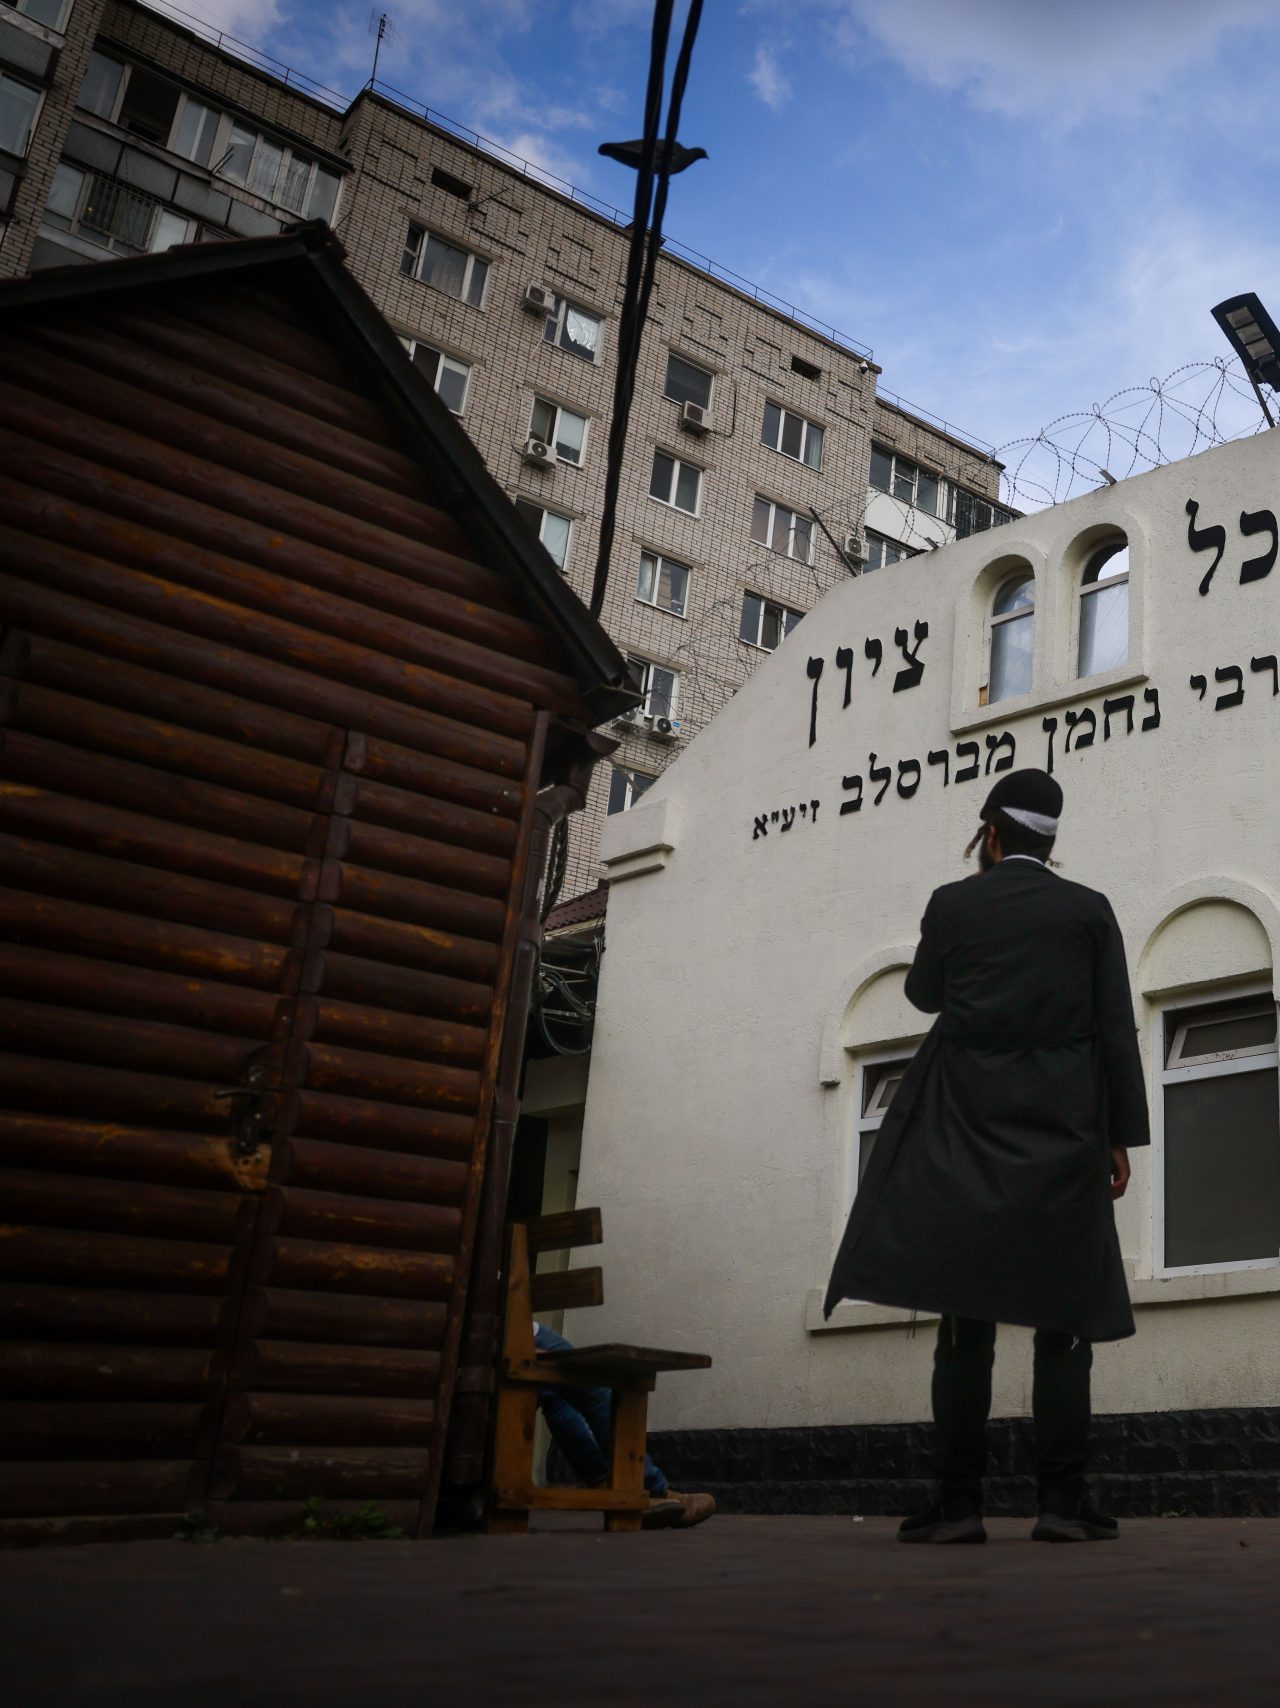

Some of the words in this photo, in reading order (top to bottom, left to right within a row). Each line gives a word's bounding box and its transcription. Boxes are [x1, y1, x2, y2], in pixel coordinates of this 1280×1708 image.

[806, 619, 929, 748] ציון
[1189, 655, 1280, 711] רבי
[839, 731, 1016, 816] מברסלב
[1042, 687, 1161, 774] נחמן
